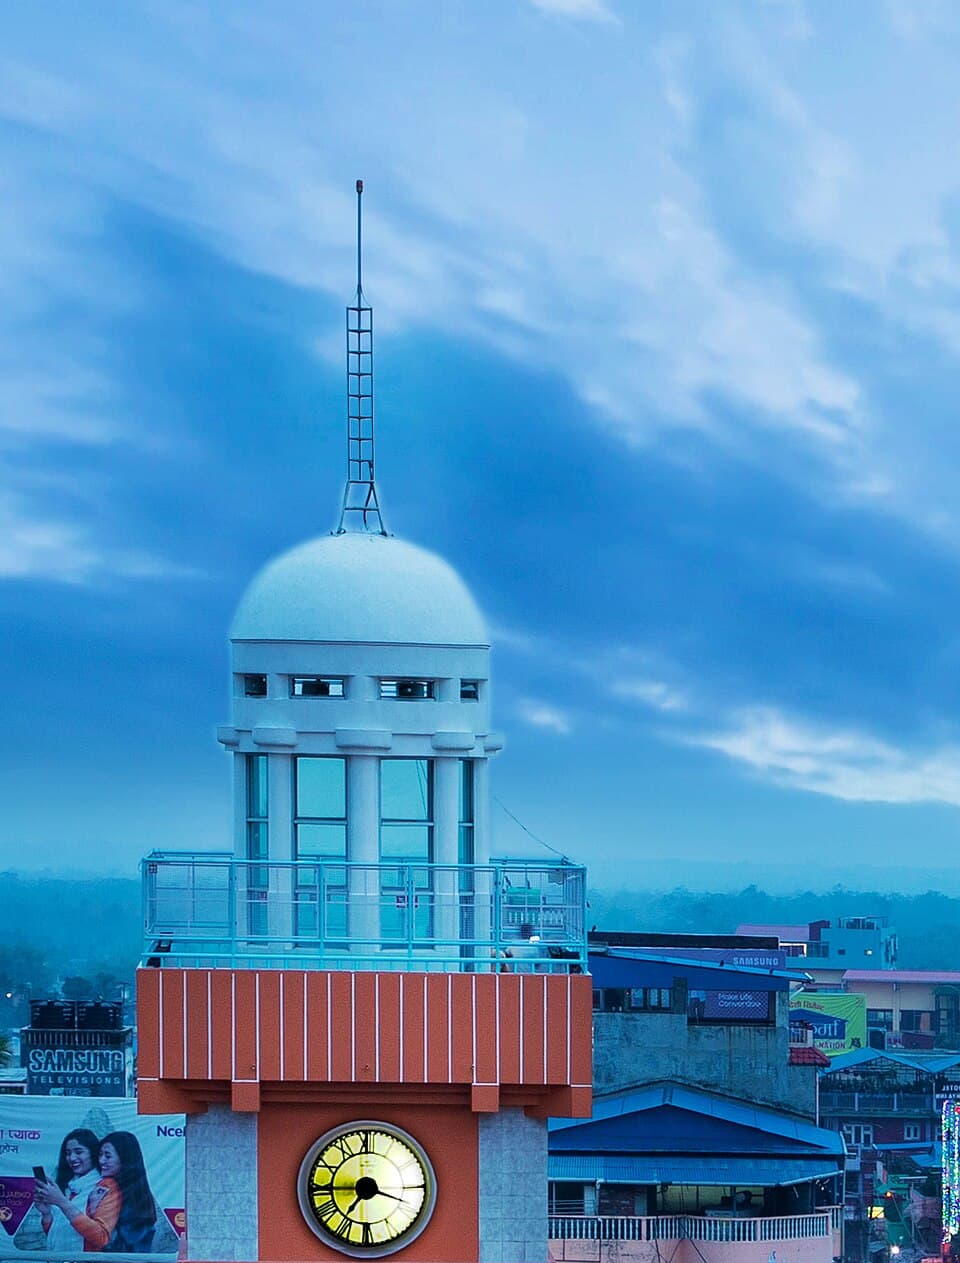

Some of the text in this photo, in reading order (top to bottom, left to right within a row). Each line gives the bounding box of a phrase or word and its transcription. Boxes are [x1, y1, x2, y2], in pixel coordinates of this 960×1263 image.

[733, 957, 779, 966] SAMSUNG
[29, 1049, 125, 1073] SAMSUNG
[33, 1075, 121, 1085] TELEVISIONS
